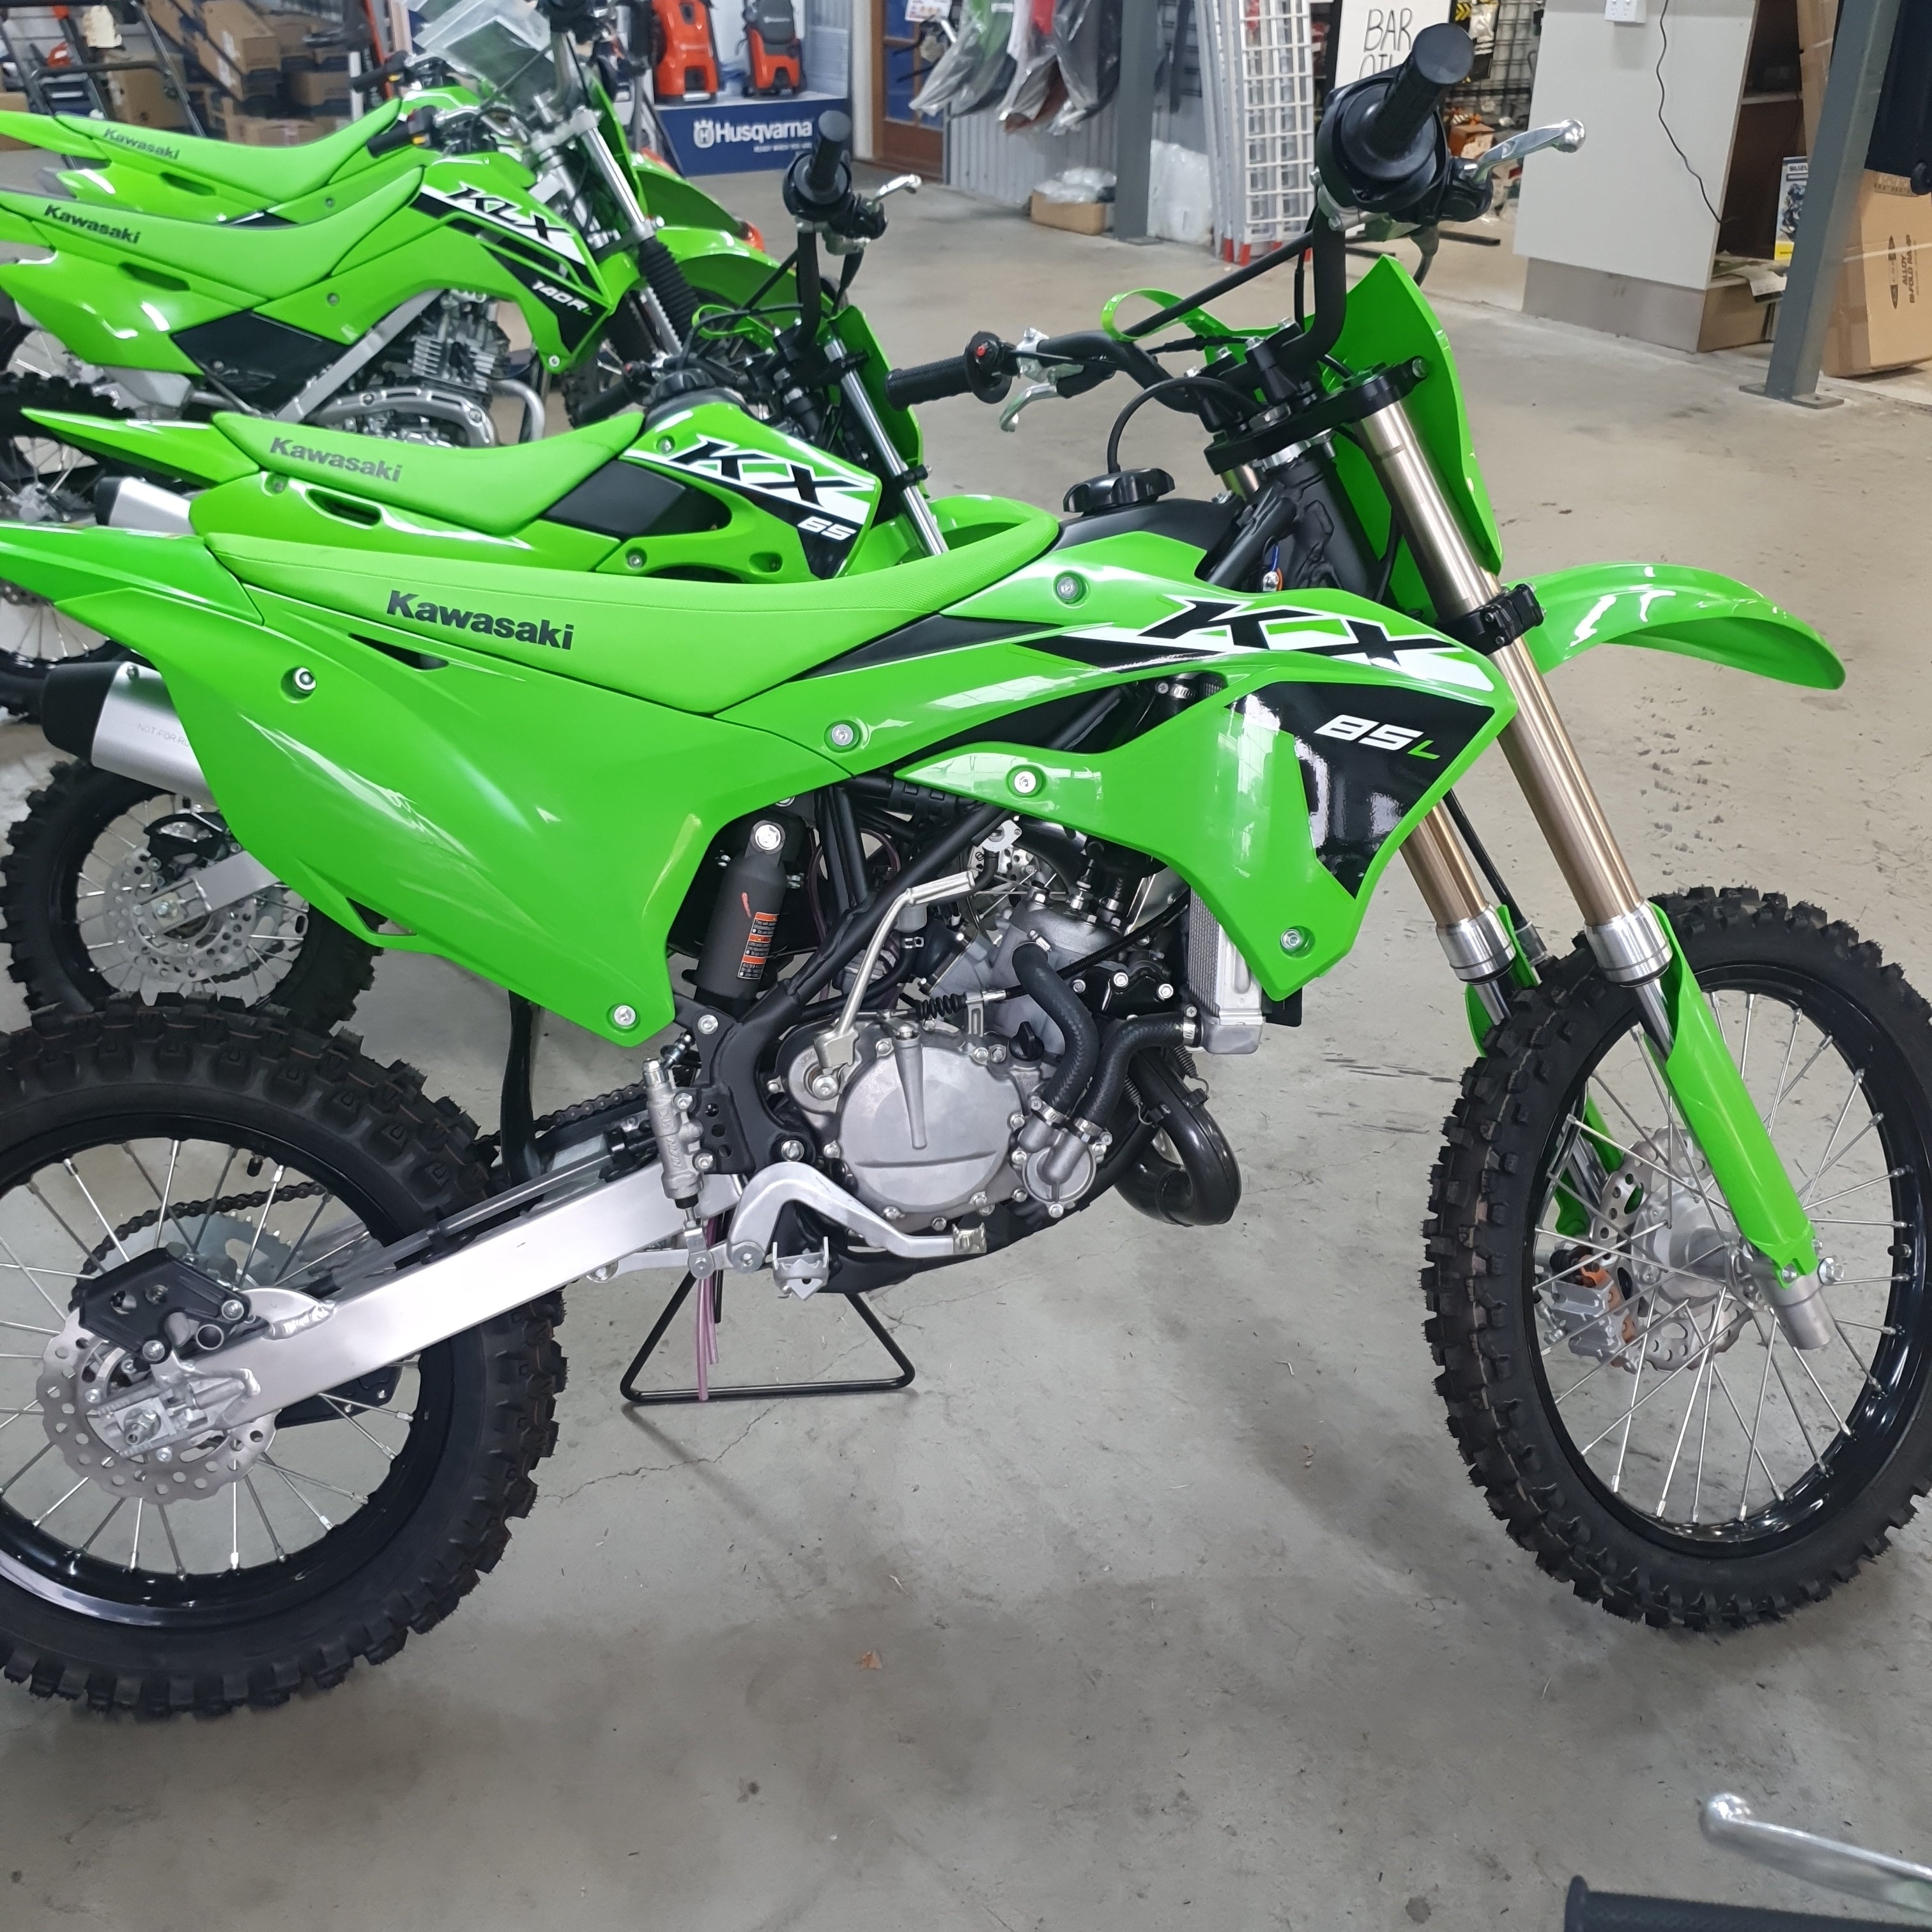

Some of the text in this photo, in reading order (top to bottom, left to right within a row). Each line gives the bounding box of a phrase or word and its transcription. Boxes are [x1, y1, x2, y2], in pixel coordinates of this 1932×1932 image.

[1363, 8, 1413, 52] BAR
[103, 127, 180, 160] Kawasaki
[714, 121, 813, 144] Husqvarna
[44, 203, 141, 244] Kawasaki
[444, 187, 572, 244] KLX
[270, 436, 403, 482] Kawasaki
[668, 440, 864, 508] KX
[797, 516, 857, 540] 65
[386, 590, 574, 650] Kawasaki
[1137, 599, 1460, 667] KX
[138, 723, 157, 734] NOT
[158, 730, 177, 741] FOR
